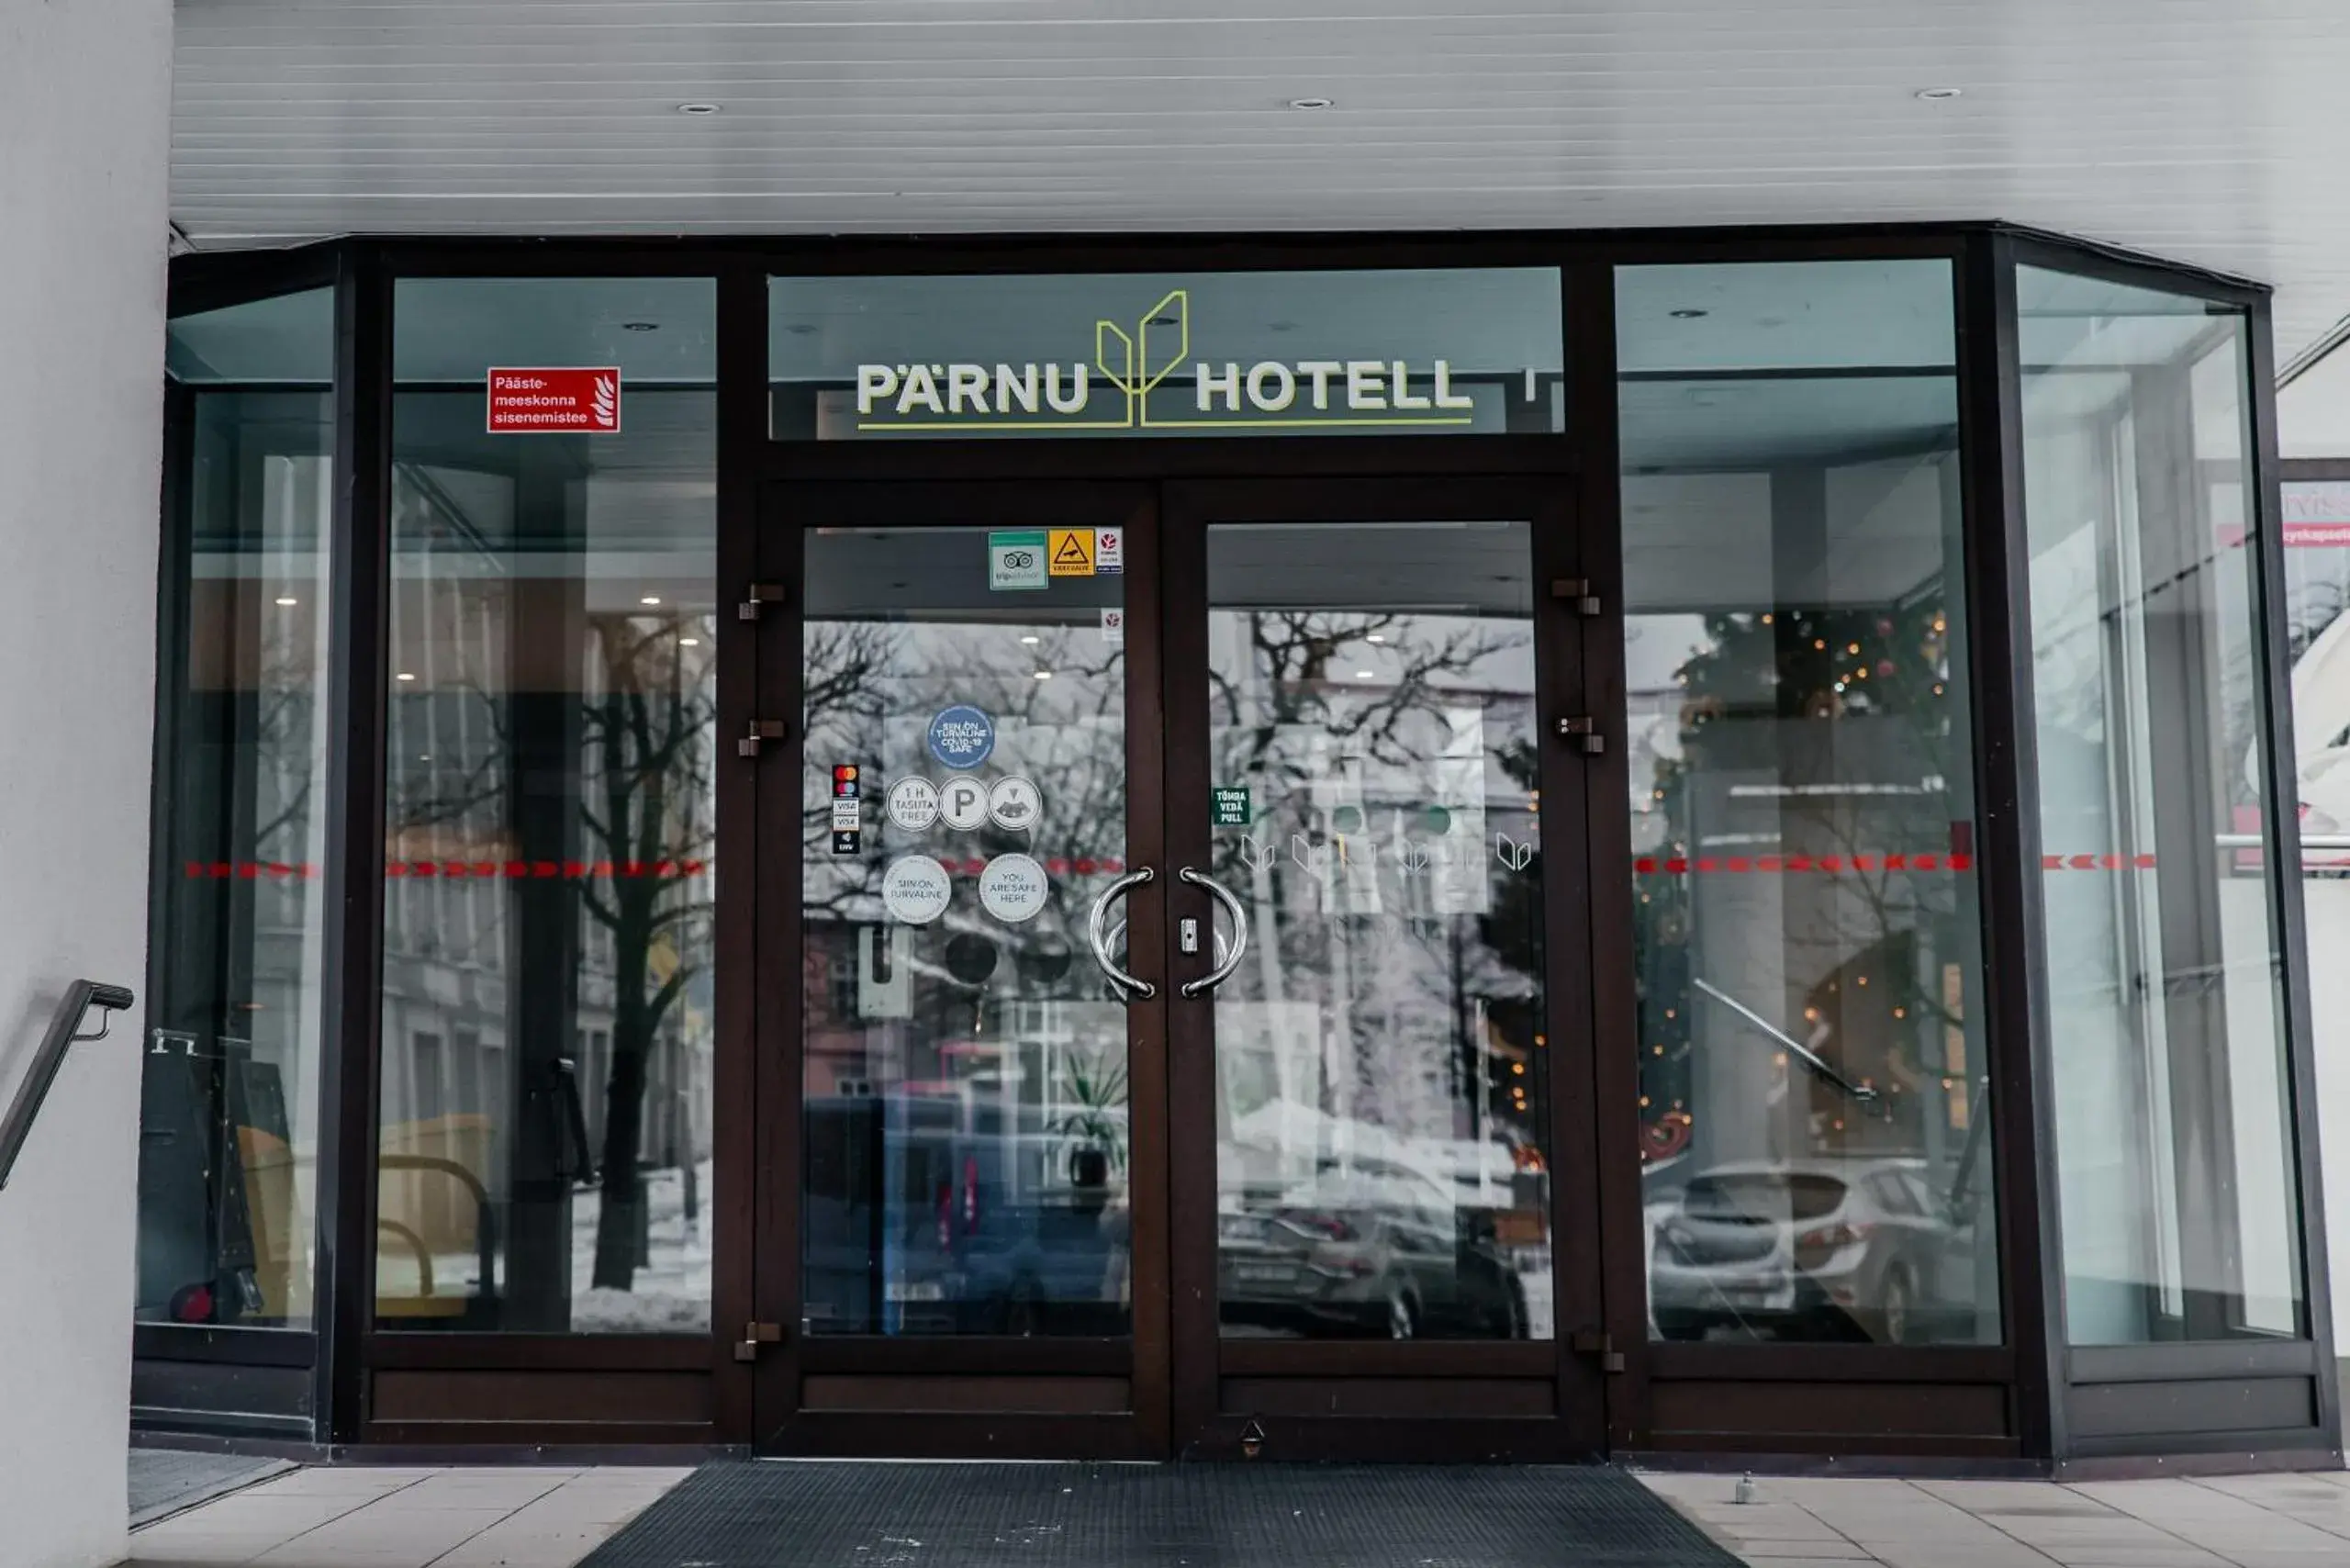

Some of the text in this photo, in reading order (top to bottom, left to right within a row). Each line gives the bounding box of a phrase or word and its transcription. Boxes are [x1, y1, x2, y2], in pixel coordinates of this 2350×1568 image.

[496, 376, 547, 389] Pääste-
[857, 360, 1473, 413] PÄRNU HOTELL
[495, 395, 576, 407] meeskonna
[495, 411, 588, 424] sisenemistee
[955, 789, 976, 817] P
[1002, 873, 1025, 882] YOU
[1001, 894, 1027, 903] HERE
